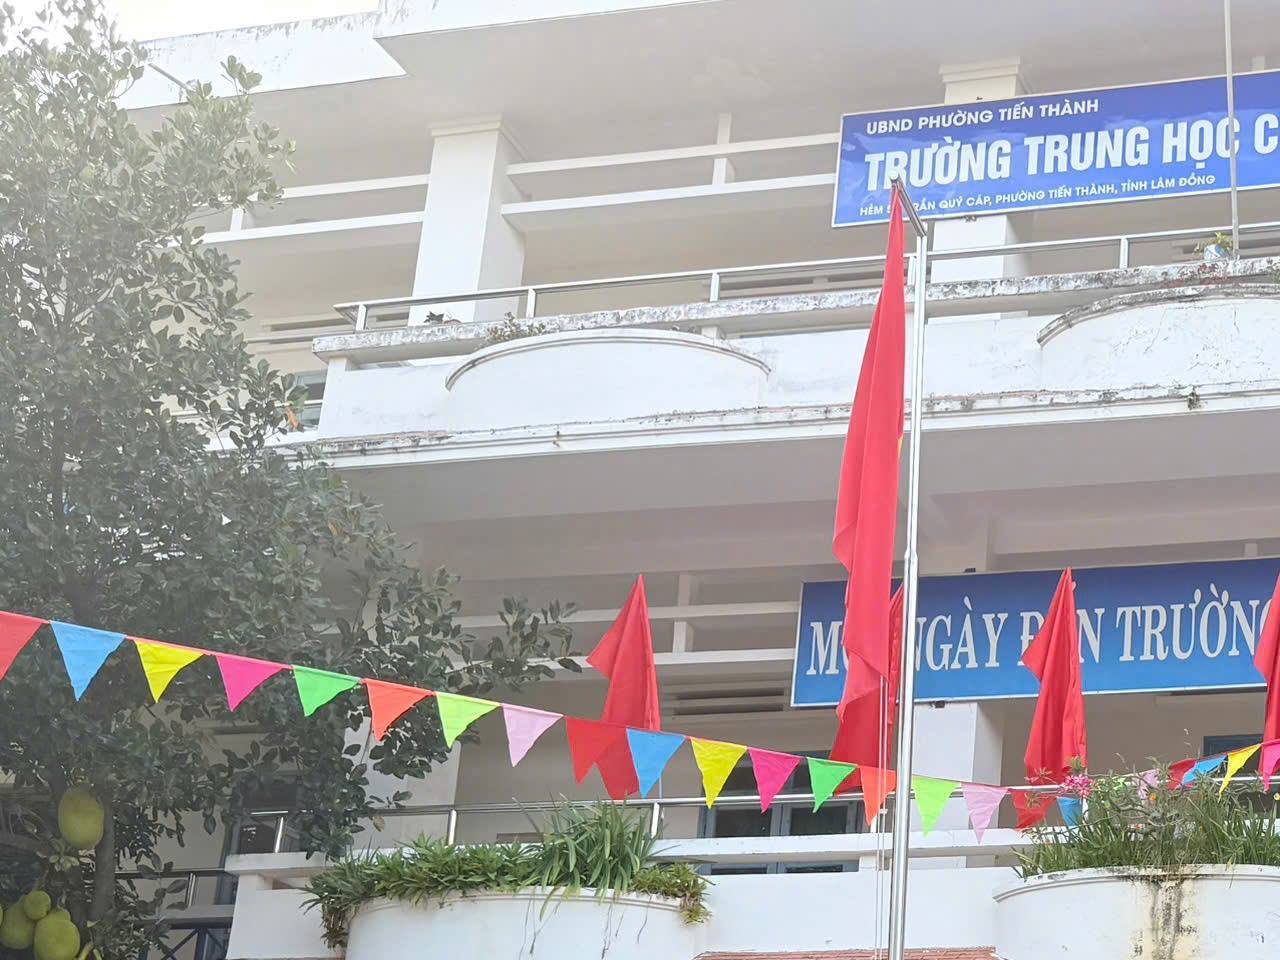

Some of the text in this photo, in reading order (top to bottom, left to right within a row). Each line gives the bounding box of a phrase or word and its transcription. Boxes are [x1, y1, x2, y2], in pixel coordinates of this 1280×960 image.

[866, 98, 1099, 136] UBND PHƯỜNG TIẾN THÀNH
[865, 136, 1012, 191] TRƯỜNG
[1023, 127, 1150, 176] TRUNG
[1162, 116, 1240, 169] HỌC
[995, 188, 1045, 204] PHƯỜNG
[1075, 183, 1118, 196] THÀNH,
[1017, 581, 1105, 666] ĐN
[1116, 583, 1272, 662] TRƯỜN
